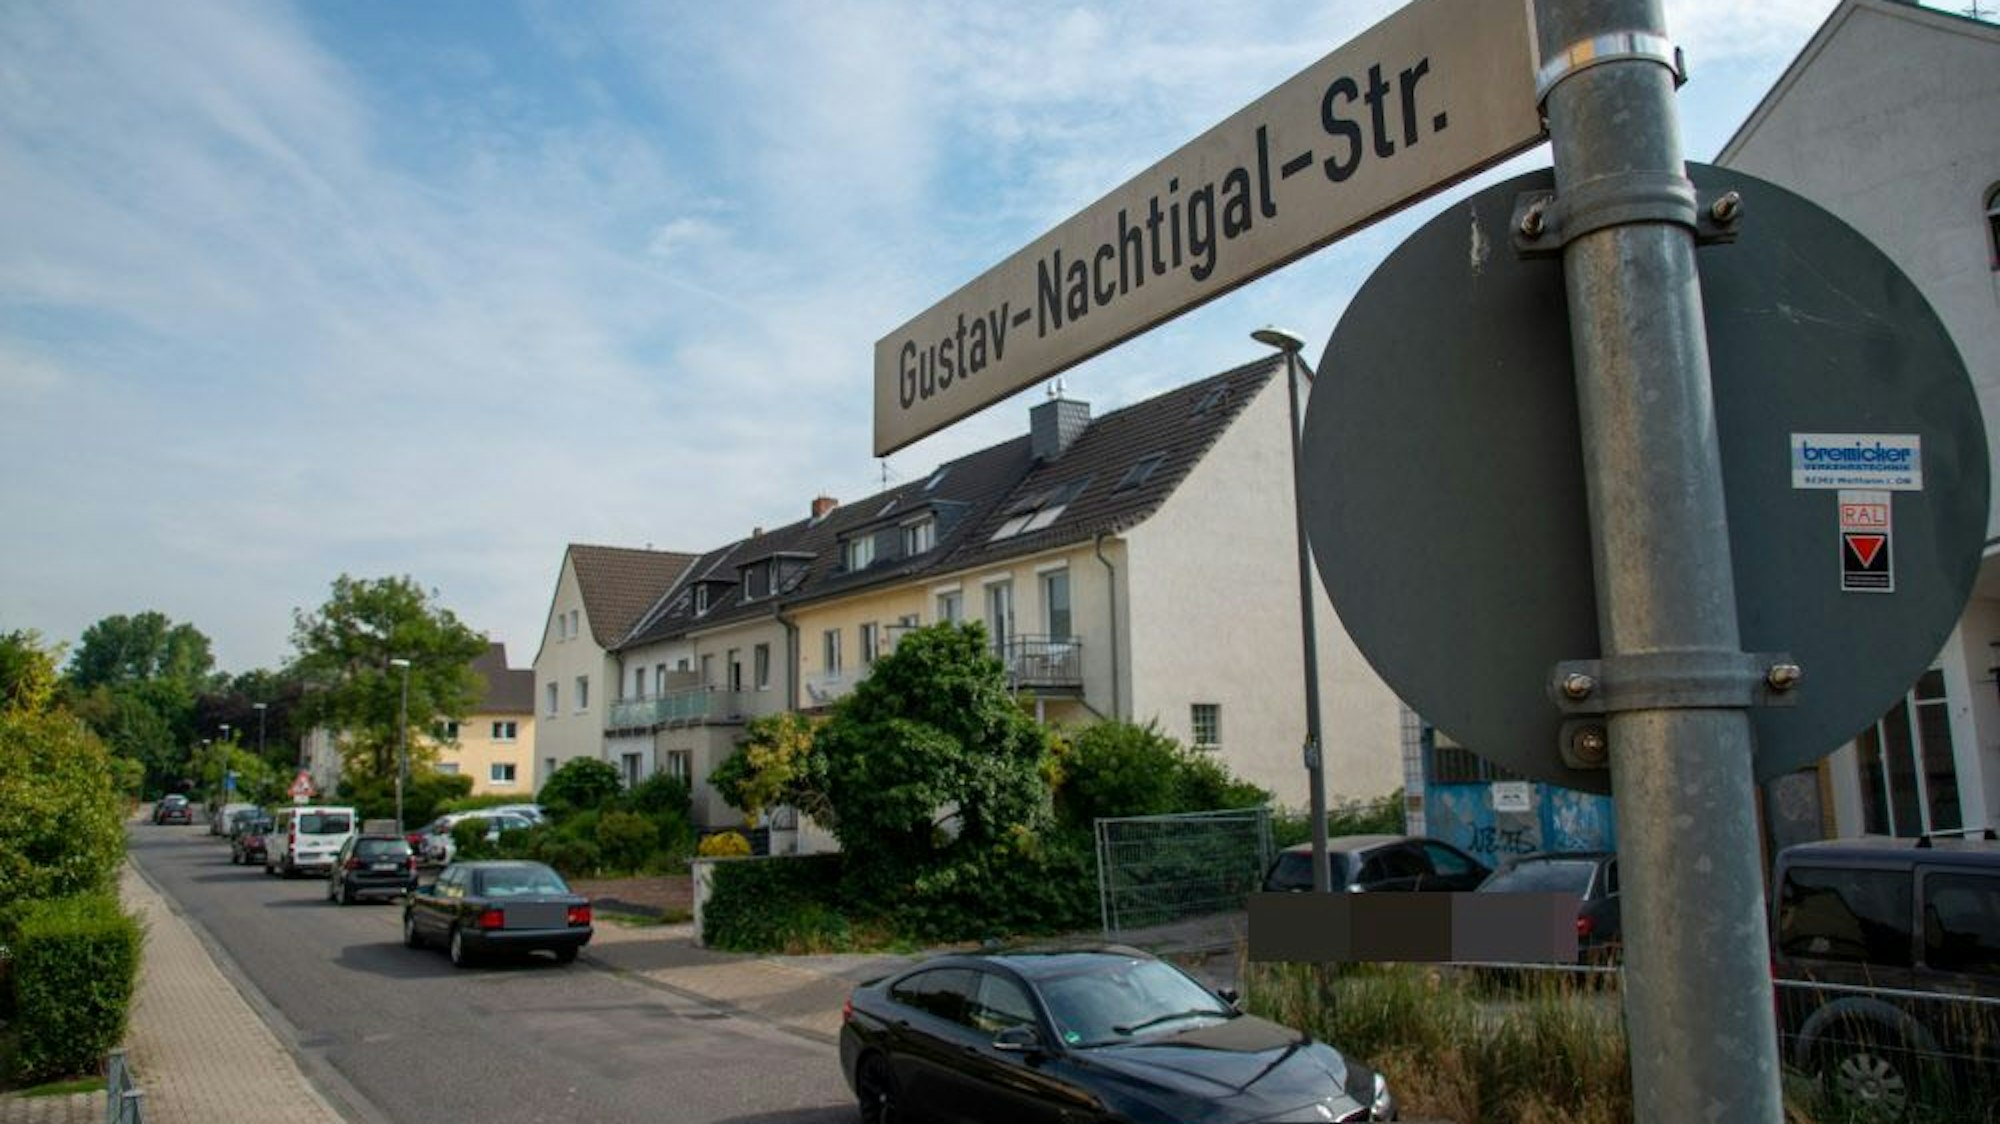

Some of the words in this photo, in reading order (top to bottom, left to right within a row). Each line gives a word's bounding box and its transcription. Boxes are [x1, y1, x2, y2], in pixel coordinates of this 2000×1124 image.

[899, 56, 1448, 410] Gustav-Nachtigal-Str.
[1803, 440, 1911, 462] bremicker
[1843, 507, 1884, 523] RAL
